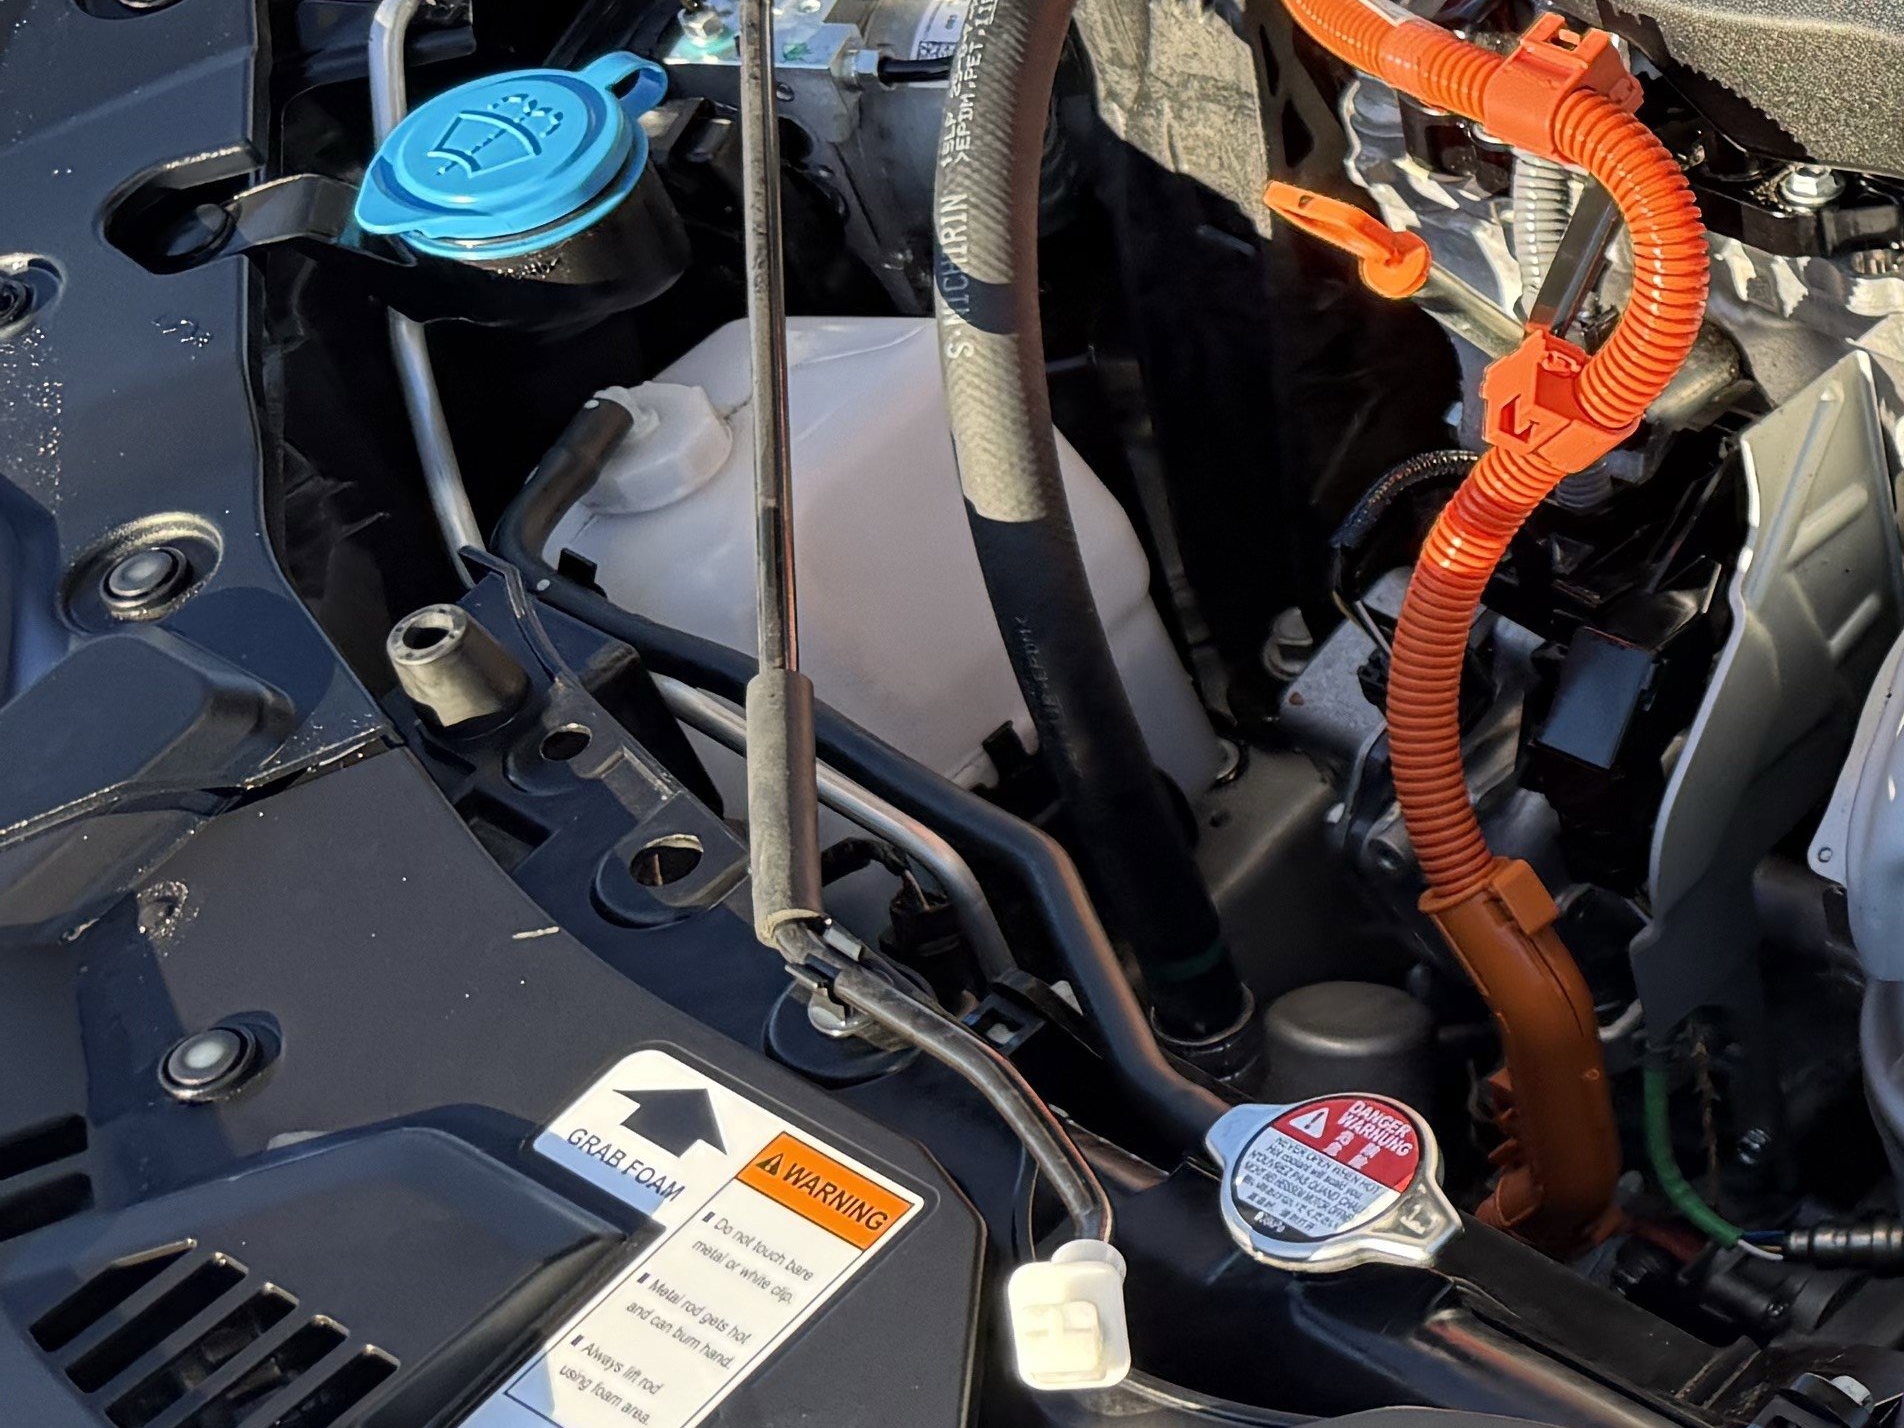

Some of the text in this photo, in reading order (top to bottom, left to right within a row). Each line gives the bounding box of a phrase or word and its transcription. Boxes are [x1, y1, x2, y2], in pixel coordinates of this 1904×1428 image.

[1336, 1110, 1414, 1158] WARNUNG
[1348, 1098, 1412, 1138] DANGER
[565, 1126, 686, 1203] GRAB FOAM
[781, 1162, 890, 1232] WARNING
[690, 1238, 796, 1307] metal or white clip.
[712, 1218, 814, 1282] Do not touch bare
[624, 1299, 736, 1369] and can burn hand.
[647, 1279, 751, 1345] Metal rod gets hot
[556, 1364, 652, 1424] using foam area.
[579, 1342, 663, 1394] Always lift rod
